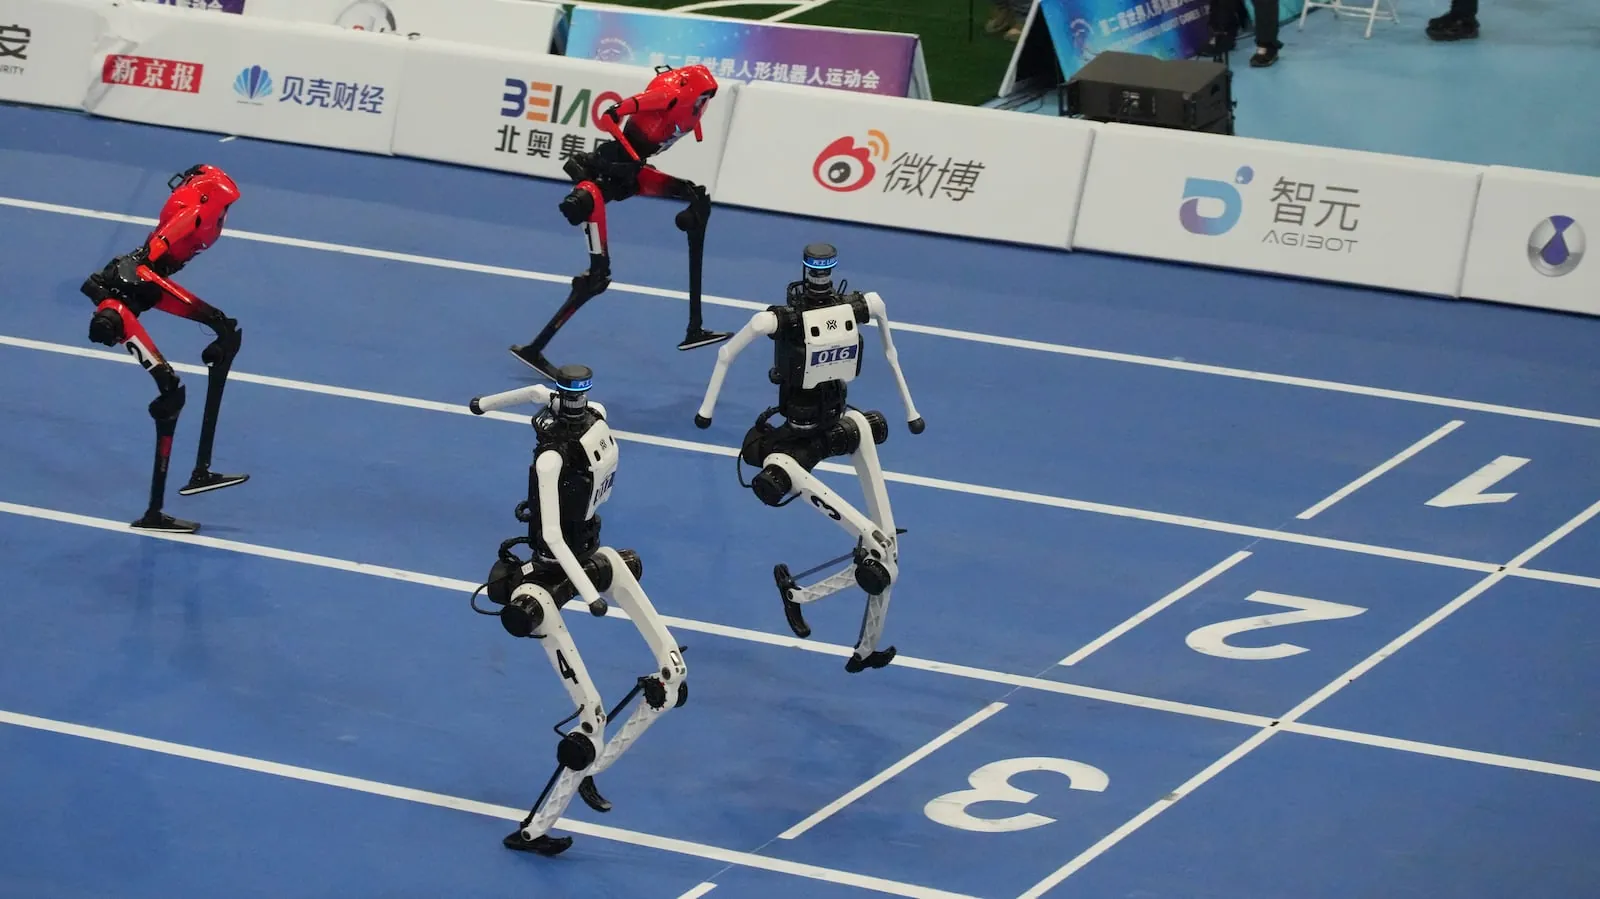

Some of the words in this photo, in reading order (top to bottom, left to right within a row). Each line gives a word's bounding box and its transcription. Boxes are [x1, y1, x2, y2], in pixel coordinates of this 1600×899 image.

[0, 24, 31, 60] 安
[111, 56, 195, 91] 新京报
[279, 76, 385, 114] 贝壳财经
[883, 152, 986, 201] 微博
[1270, 176, 1361, 231] 智元
[1261, 229, 1359, 253] AGIBOT
[126, 341, 153, 369] 2
[818, 348, 850, 363] 016
[1424, 455, 1531, 507] 1
[810, 495, 841, 521] 3
[1185, 590, 1368, 660] 2
[556, 649, 578, 684] 4
[923, 757, 1110, 832] 3
